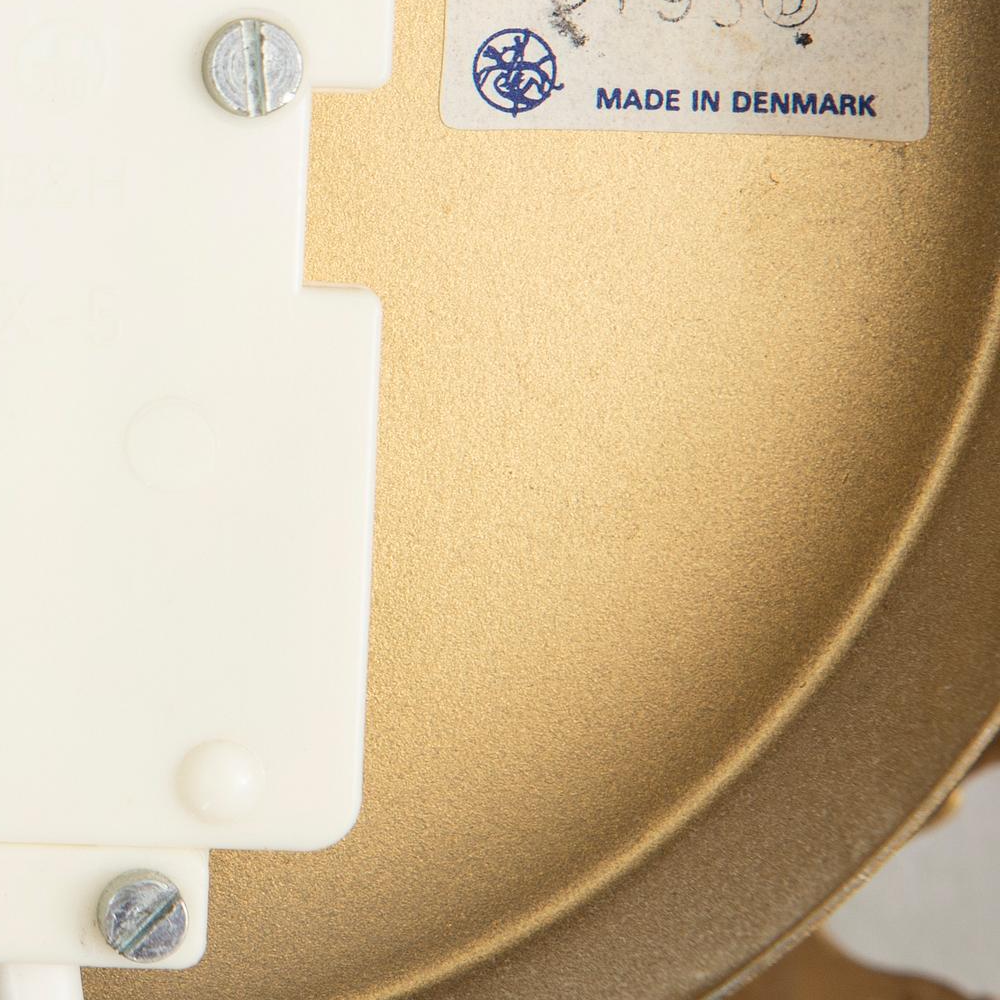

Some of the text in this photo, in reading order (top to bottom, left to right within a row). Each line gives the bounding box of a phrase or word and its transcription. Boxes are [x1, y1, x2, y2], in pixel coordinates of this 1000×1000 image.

[596, 88, 878, 118] MADE IN DENMARK
